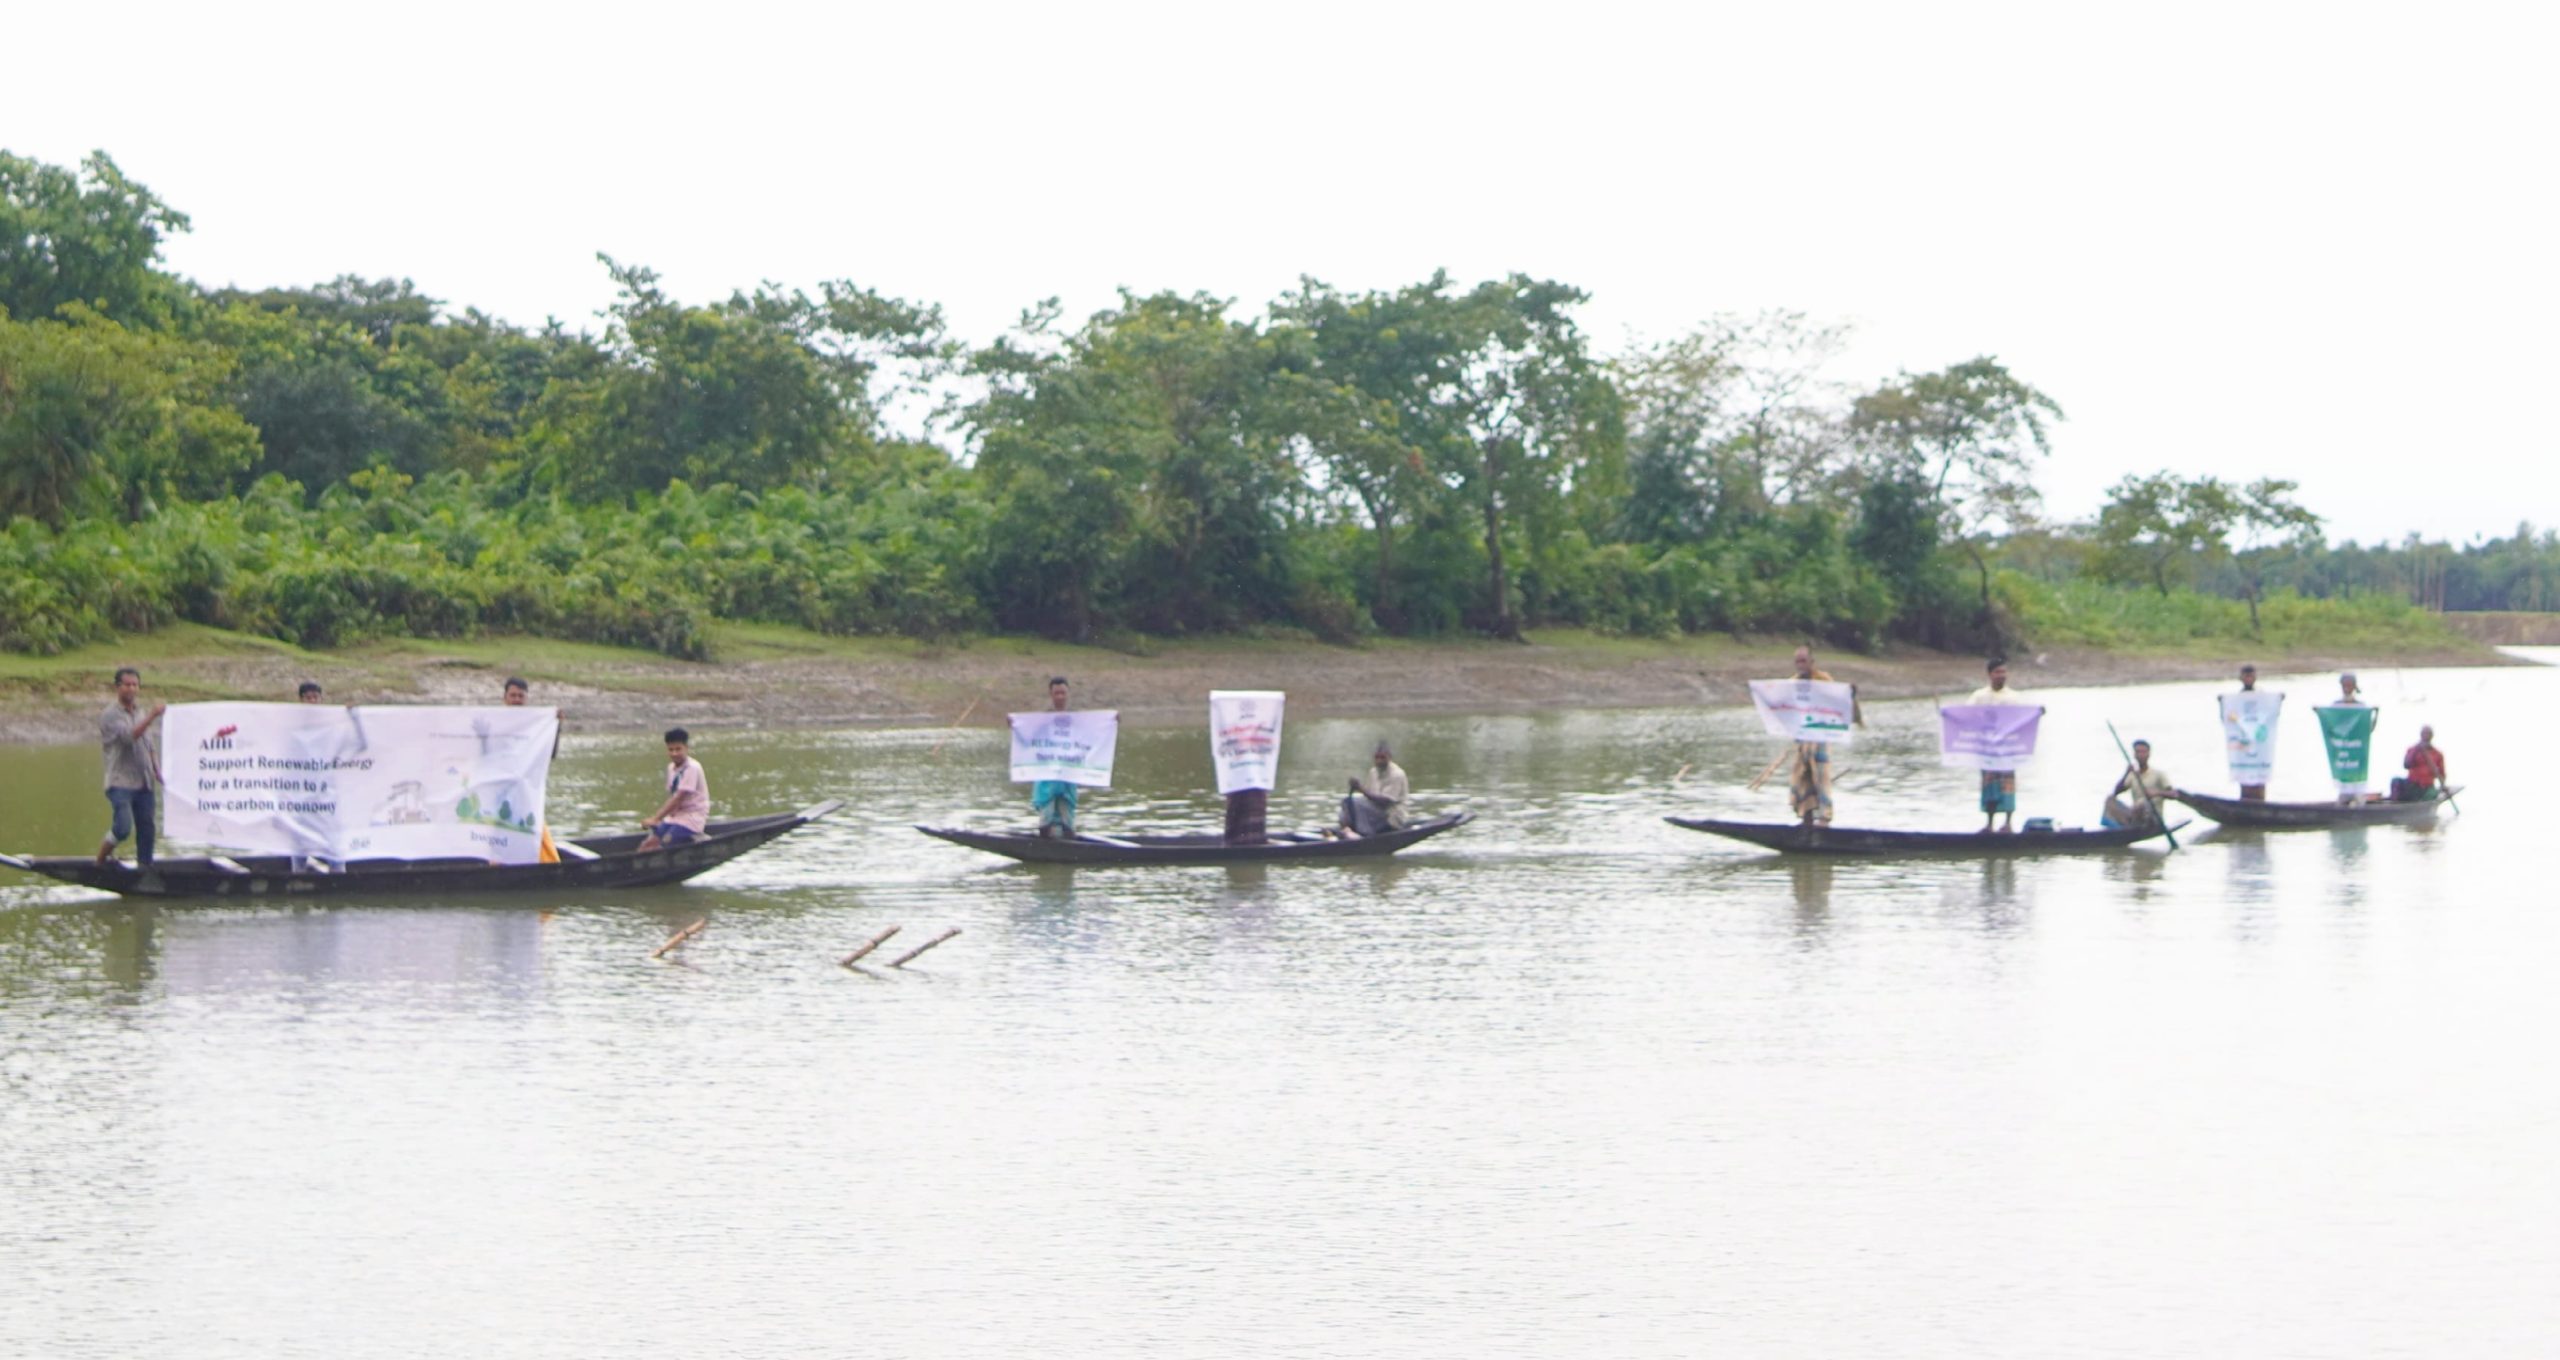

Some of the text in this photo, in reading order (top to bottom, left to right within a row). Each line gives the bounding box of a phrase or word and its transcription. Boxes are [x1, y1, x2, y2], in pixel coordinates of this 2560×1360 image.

[199, 757, 374, 772] Support Renewable Energy
[198, 778, 217, 790] for
[221, 780, 229, 790] a
[233, 777, 300, 791] transition
[303, 779, 317, 792] to
[198, 799, 336, 815] low-carbon economy
